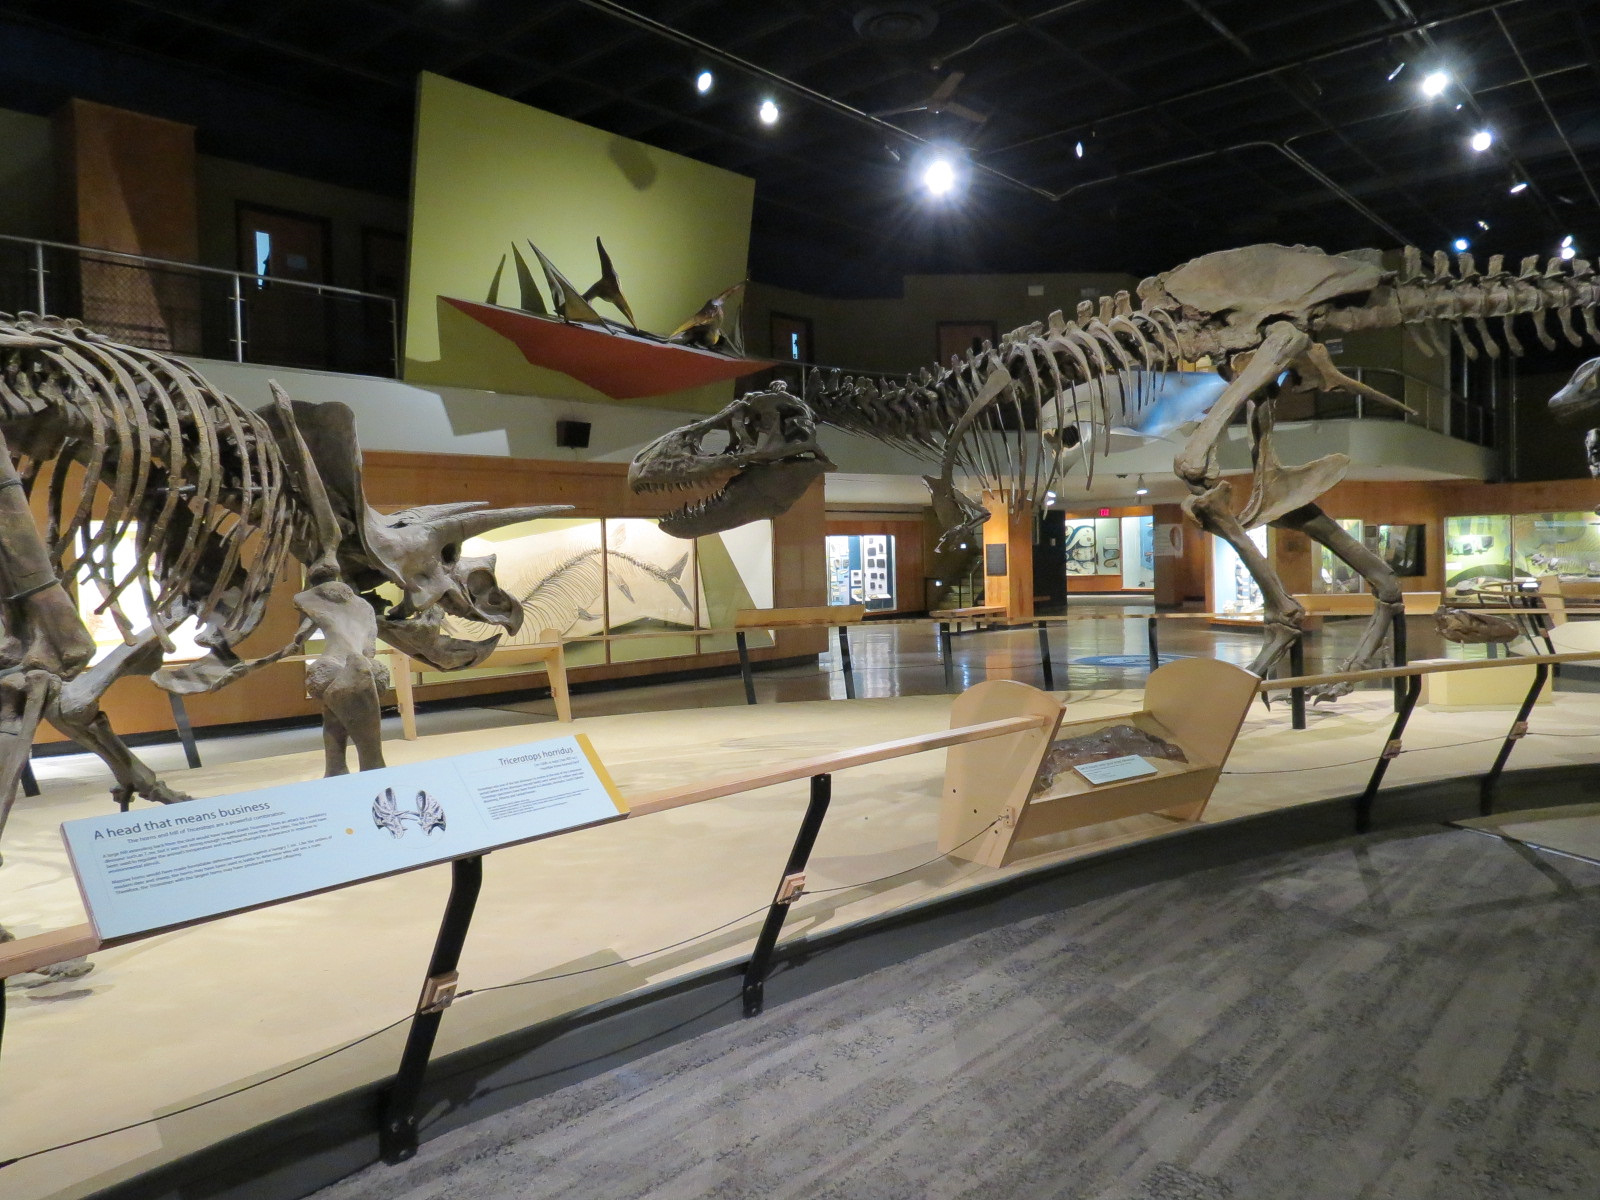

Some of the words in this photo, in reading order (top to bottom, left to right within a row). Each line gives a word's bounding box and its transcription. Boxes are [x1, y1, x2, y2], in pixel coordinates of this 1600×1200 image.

[498, 752, 542, 767] Triceratops
[542, 746, 574, 758] horridus
[94, 830, 104, 840] A
[107, 823, 141, 838] head
[144, 818, 172, 831] that
[175, 811, 217, 826] means
[218, 802, 271, 818] business
